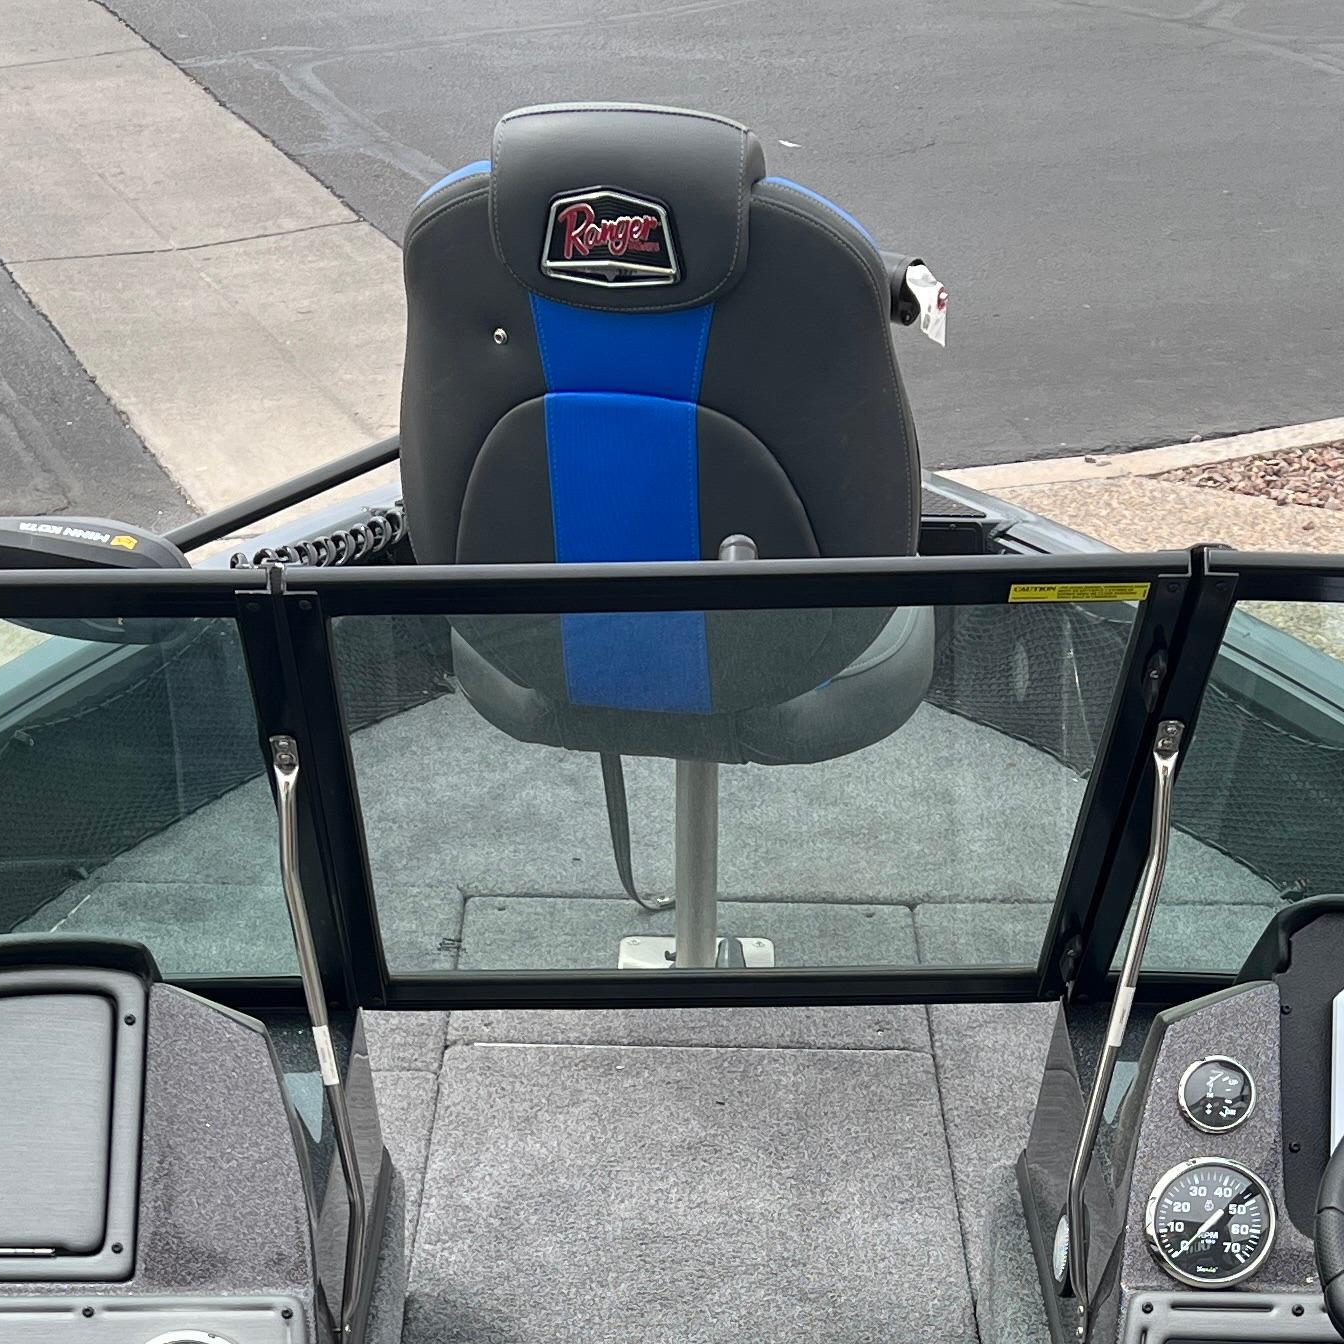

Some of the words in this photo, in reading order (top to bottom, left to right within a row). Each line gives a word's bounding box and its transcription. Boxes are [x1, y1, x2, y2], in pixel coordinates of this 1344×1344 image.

[558, 203, 659, 259] Ranger
[19, 522, 63, 535] KOTA
[63, 527, 111, 542] MINN
[1189, 1187, 1207, 1197] 30
[1213, 1187, 1232, 1197] 40
[1172, 1202, 1191, 1212] 20
[1228, 1204, 1246, 1214] 50
[1167, 1222, 1185, 1232] 10
[1231, 1224, 1249, 1234] 60
[1222, 1242, 1241, 1252] 70
